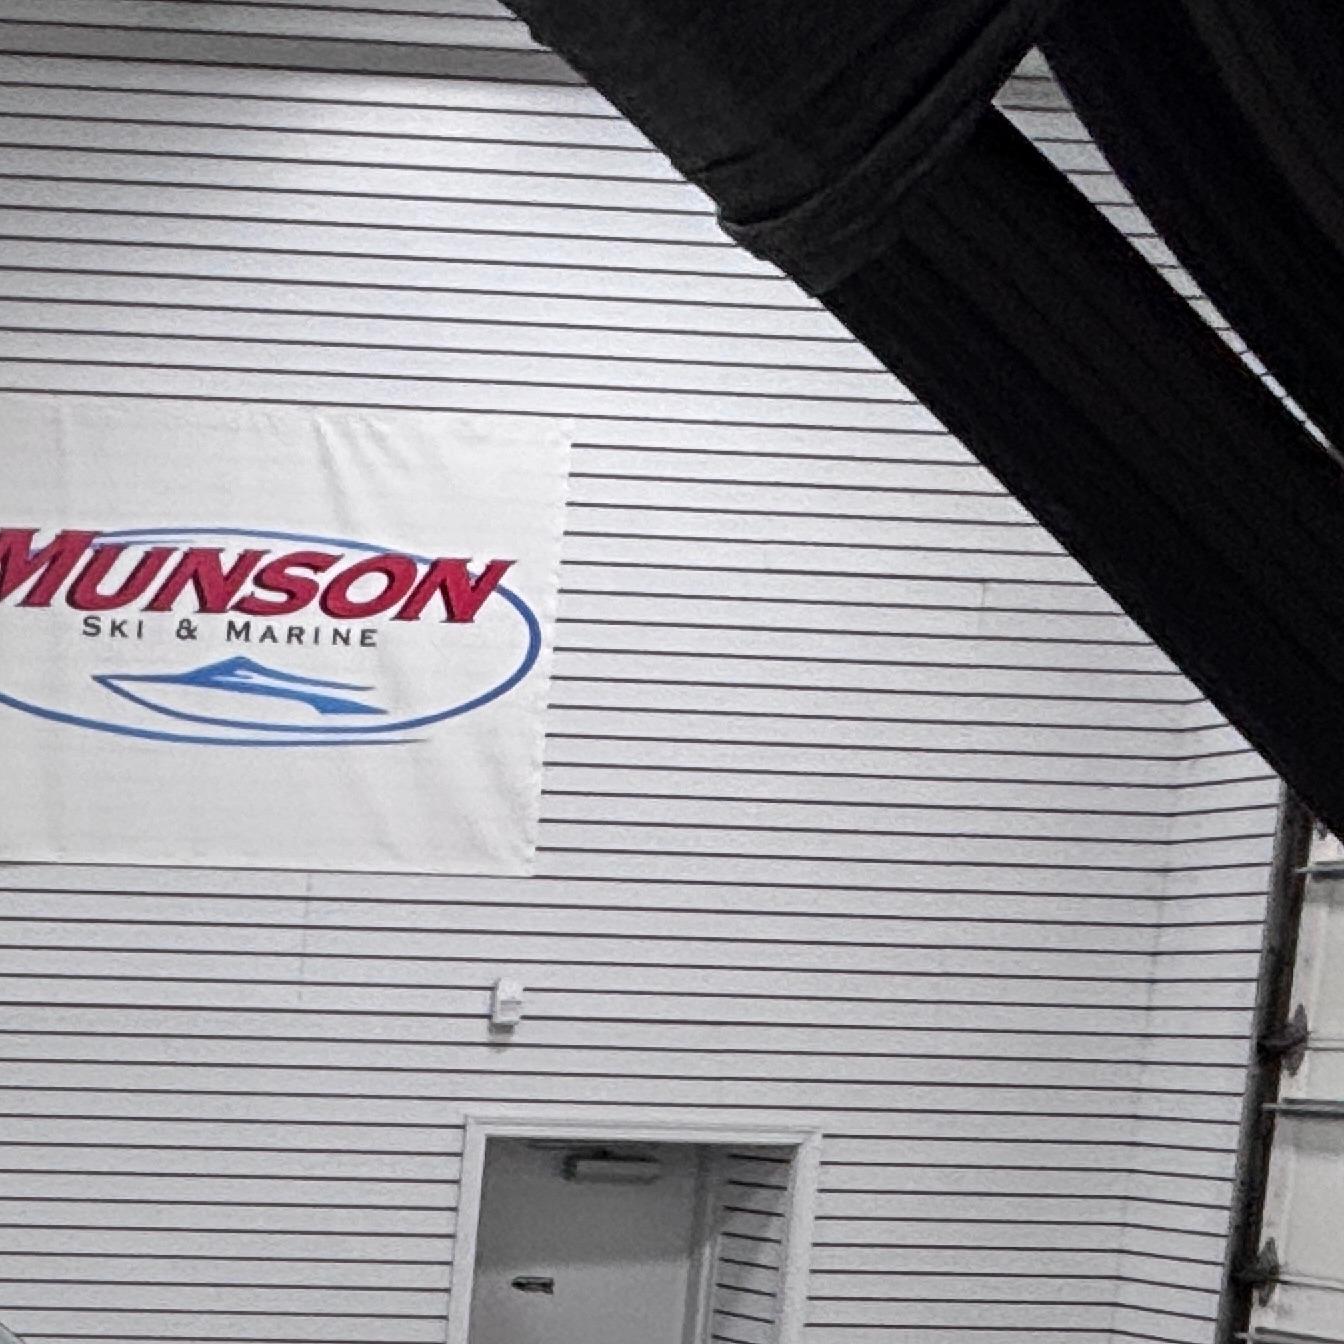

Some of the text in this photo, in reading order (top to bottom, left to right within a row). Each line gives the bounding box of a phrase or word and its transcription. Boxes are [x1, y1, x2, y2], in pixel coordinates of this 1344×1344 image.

[82, 615, 378, 648] SKI & MARINE
